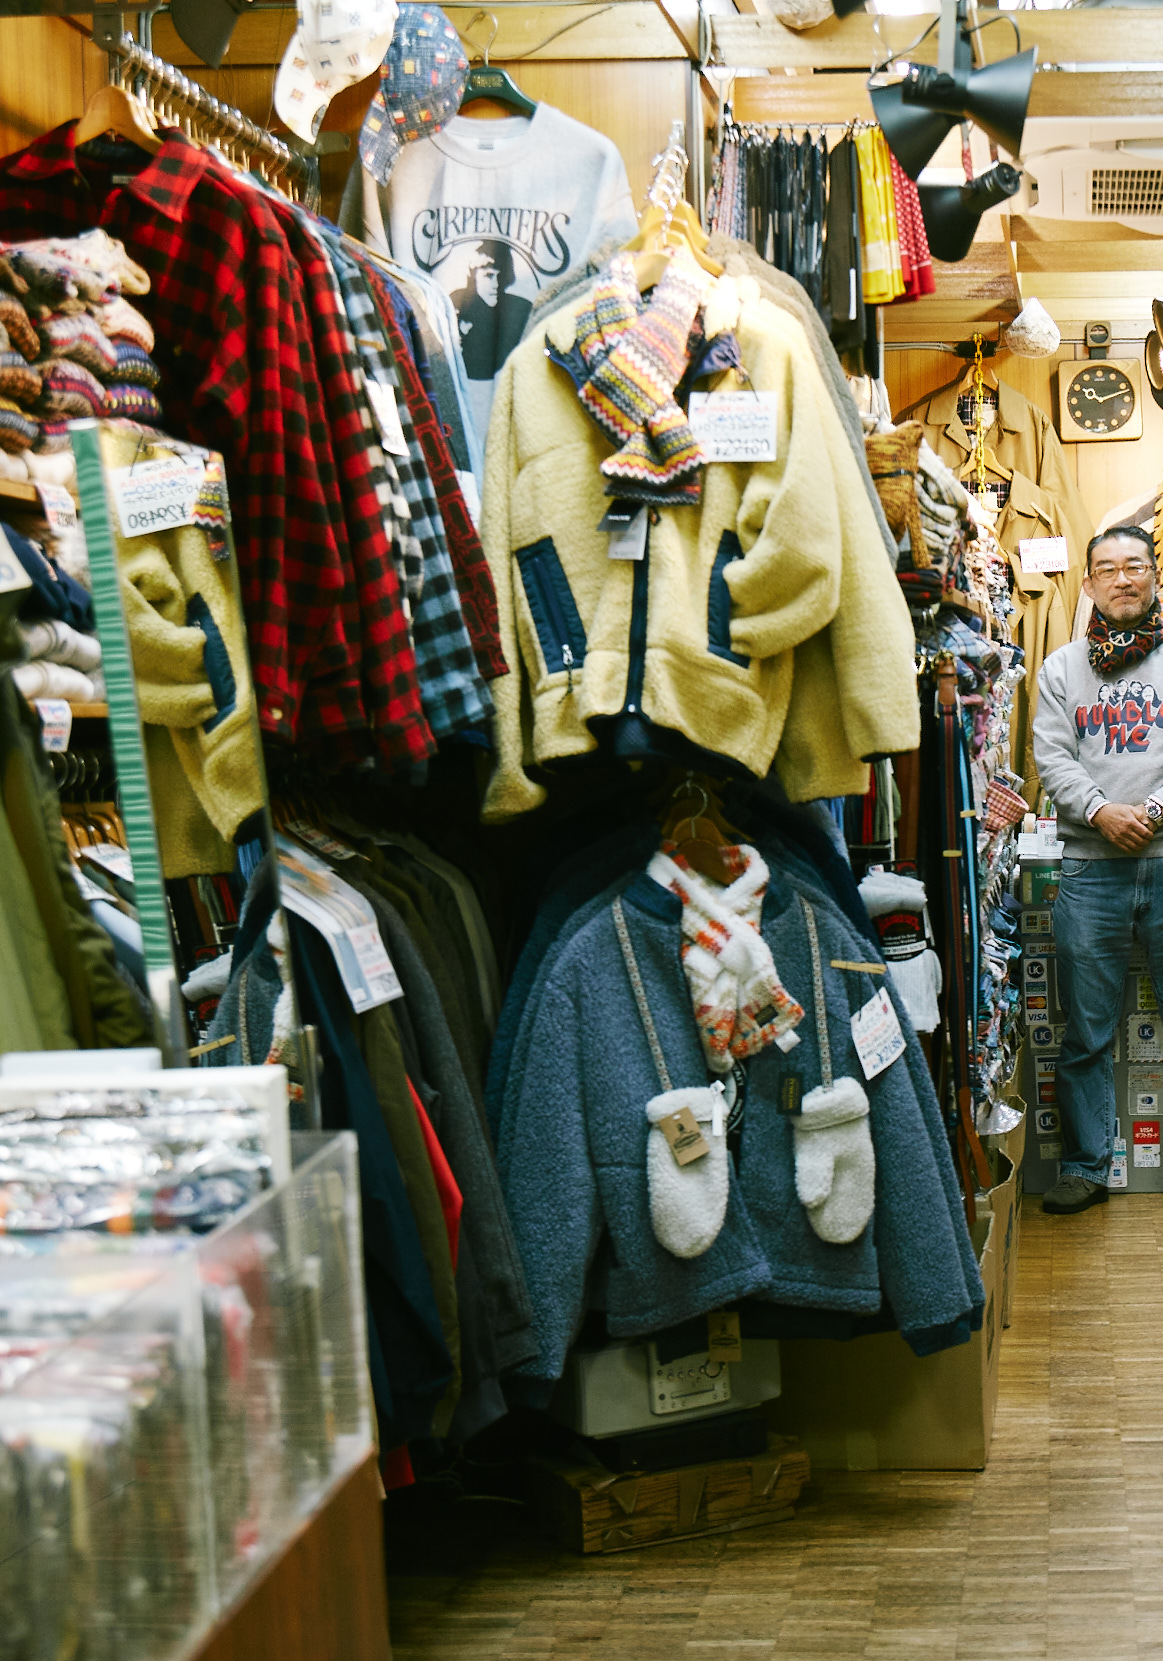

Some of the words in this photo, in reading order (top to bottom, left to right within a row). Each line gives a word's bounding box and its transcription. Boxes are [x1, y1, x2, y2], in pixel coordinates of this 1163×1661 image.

[412, 206, 571, 276] CARPENTERS
[1104, 723, 1151, 754] PIE
[1028, 965, 1045, 975] UC
[1028, 1013, 1048, 1021] VISA
[1034, 1030, 1052, 1041] UC
[1139, 1027, 1154, 1037] UC
[1040, 1116, 1058, 1126] UC
